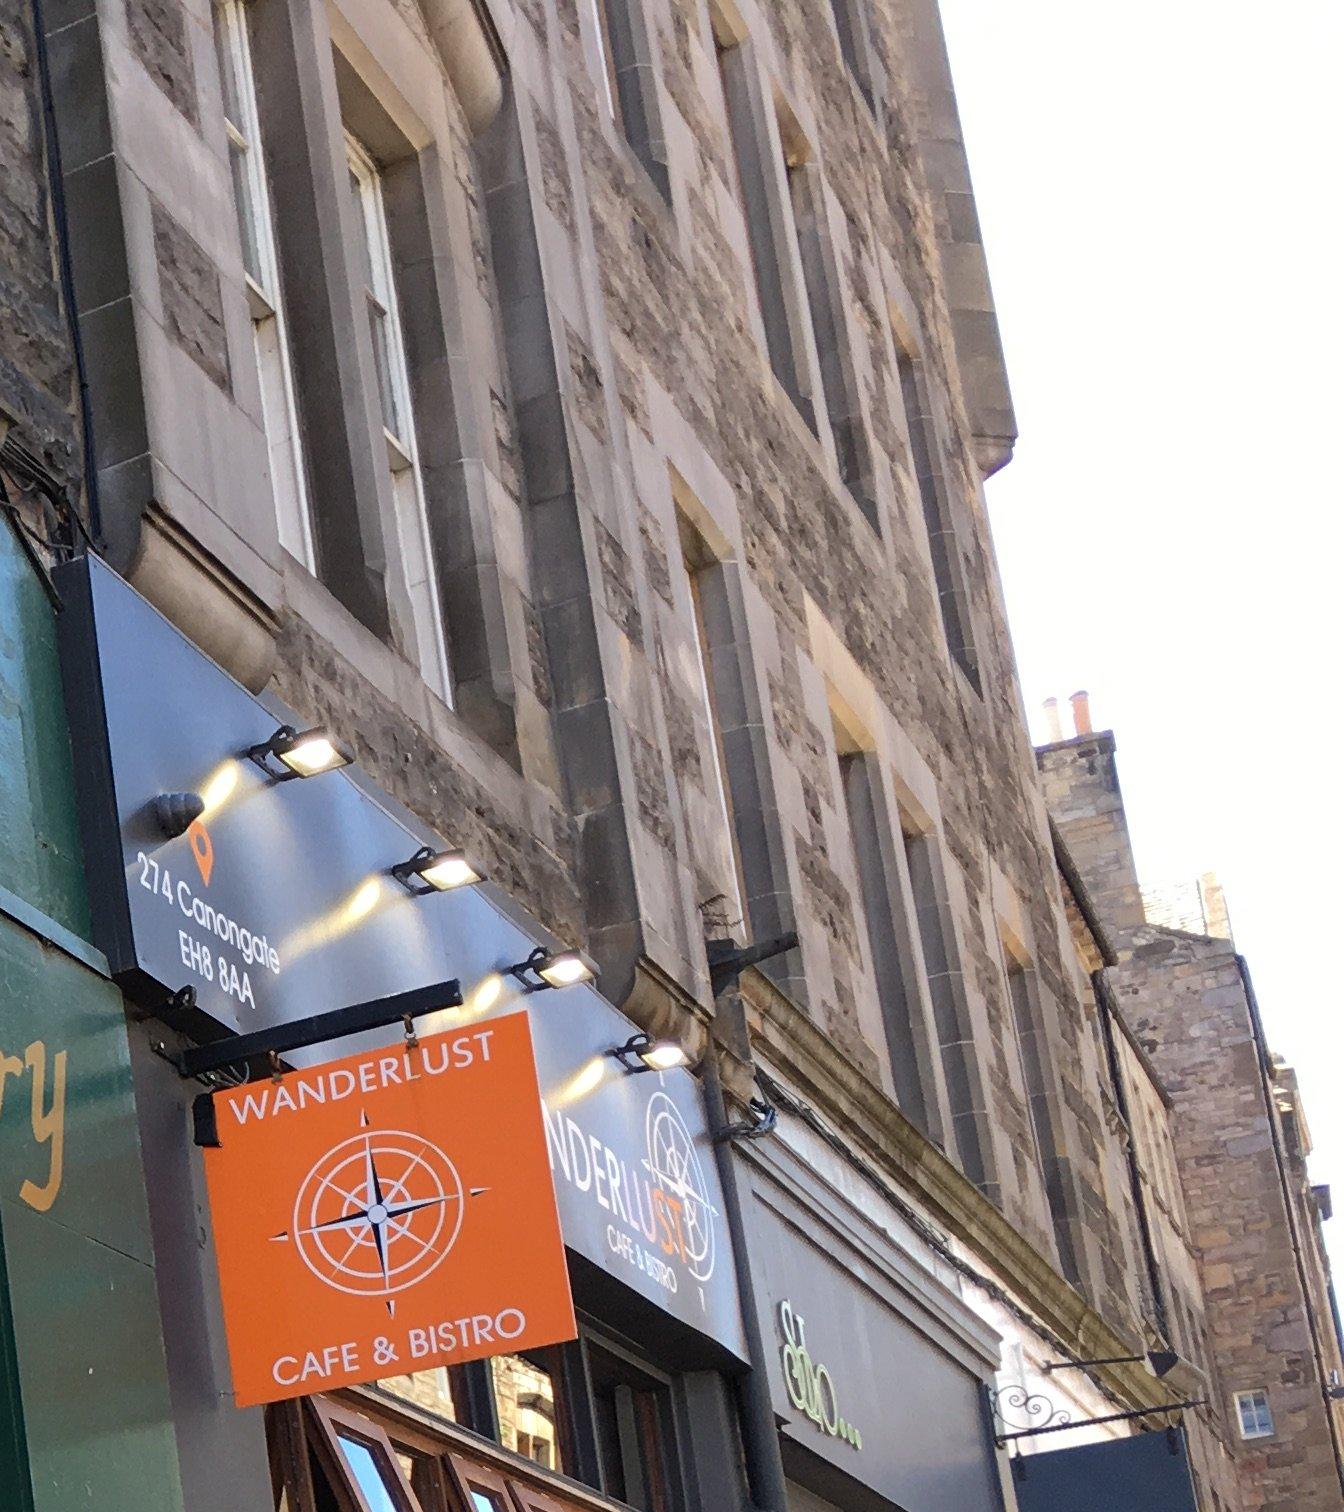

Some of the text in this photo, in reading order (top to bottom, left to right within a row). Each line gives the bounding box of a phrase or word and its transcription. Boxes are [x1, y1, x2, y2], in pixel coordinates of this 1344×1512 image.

[137, 851, 281, 975] 274 Canongate
[178, 929, 256, 1010] EH8 8AA
[228, 1030, 495, 1126] WANDERLUST
[607, 1224, 636, 1265] CAFE
[272, 1306, 527, 1386] CAFE & BISTRO
